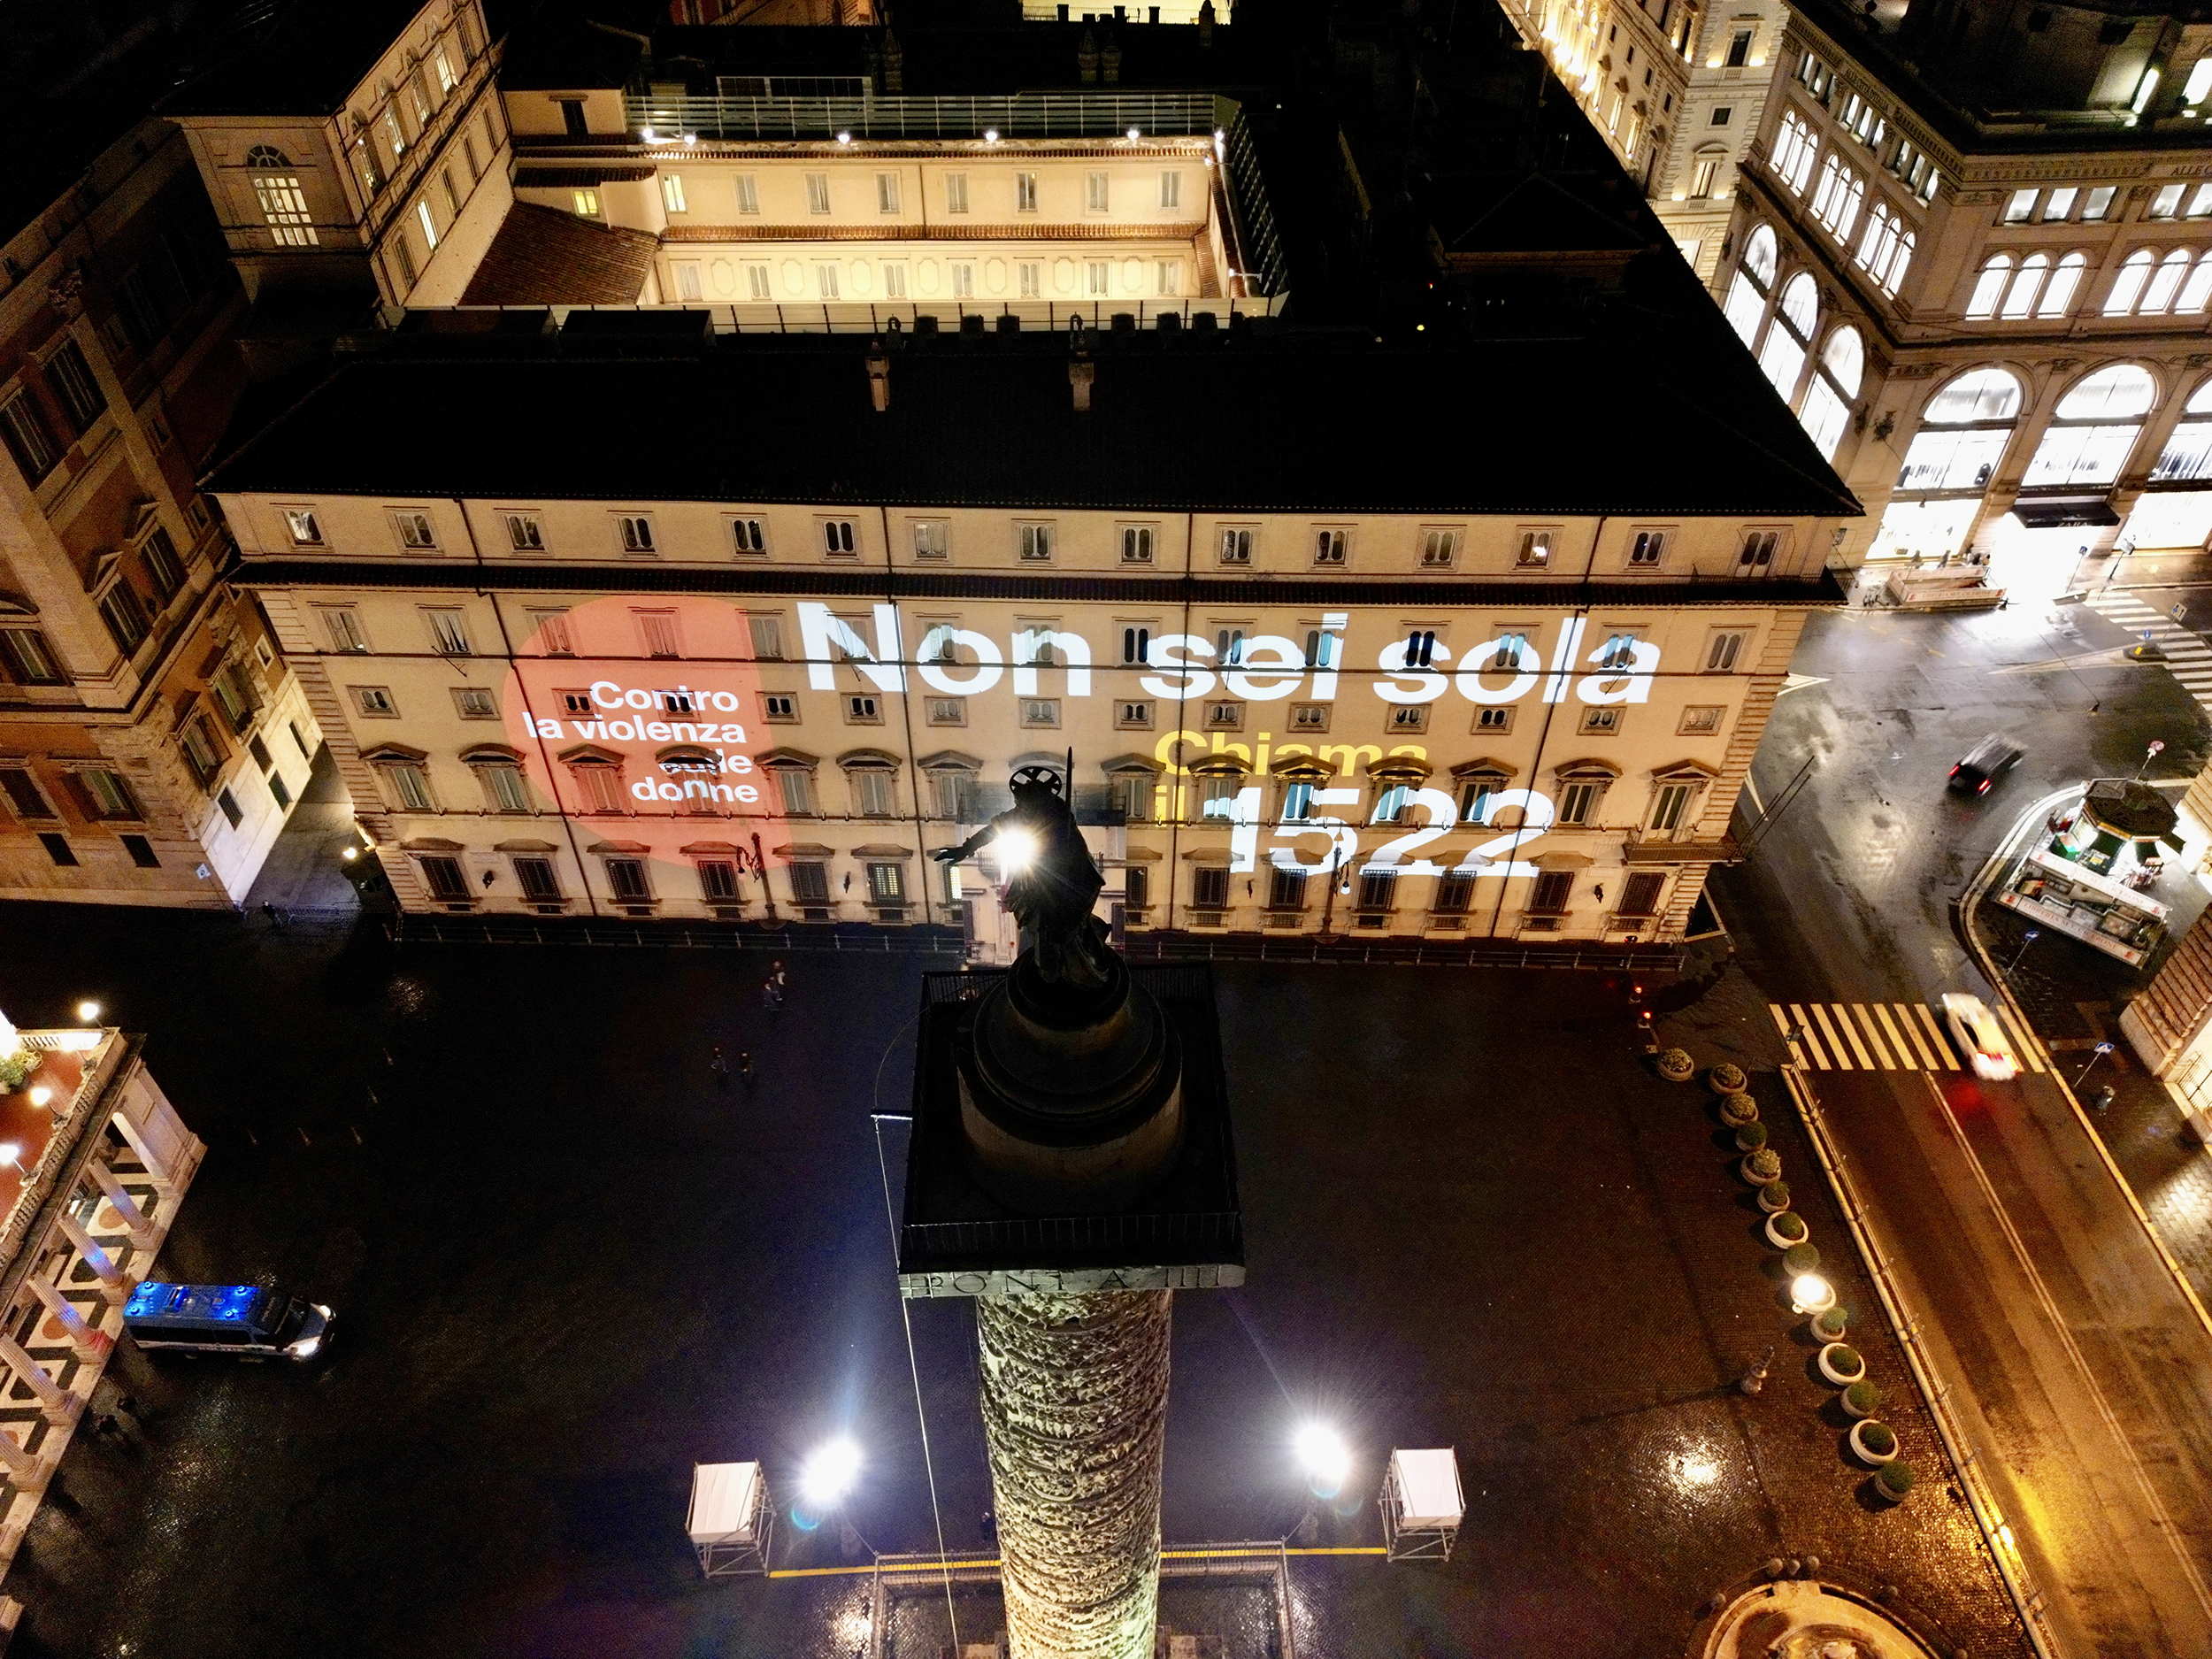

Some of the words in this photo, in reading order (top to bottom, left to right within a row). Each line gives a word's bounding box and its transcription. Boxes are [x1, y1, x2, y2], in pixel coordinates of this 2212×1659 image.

[797, 602, 1091, 697] Non
[1140, 612, 1348, 701] sei
[1372, 617, 1662, 704] sola
[590, 680, 739, 711] Contro
[522, 711, 565, 740] la
[572, 713, 747, 743] violenza
[631, 776, 759, 803] donne
[1155, 785, 1185, 827] il
[1204, 786, 1555, 878] 1522
